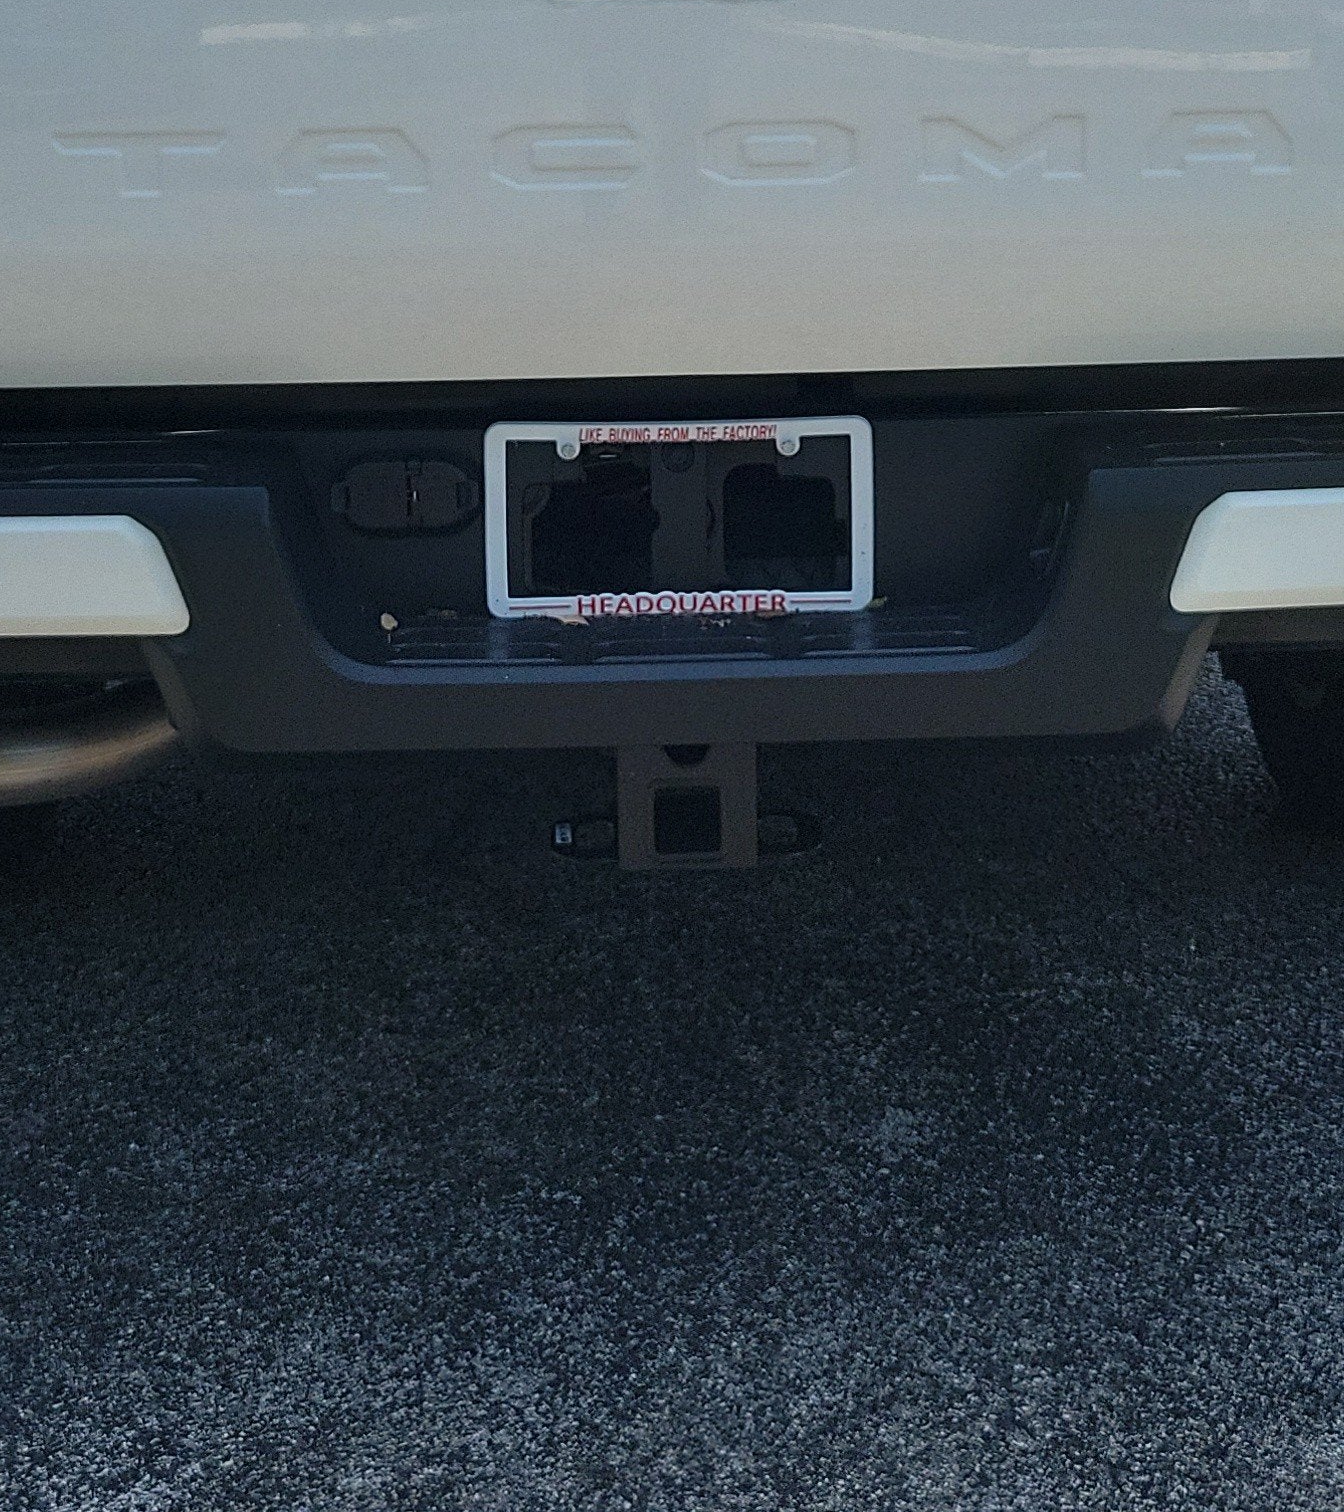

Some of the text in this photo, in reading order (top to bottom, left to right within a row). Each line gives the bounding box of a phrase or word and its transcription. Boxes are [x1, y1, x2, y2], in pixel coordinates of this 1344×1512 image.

[51, 108, 1293, 198] TACOMA
[579, 424, 777, 442] LIKE BUYING FROM THE FACTORY!
[577, 593, 787, 615] HEADQUARTER
